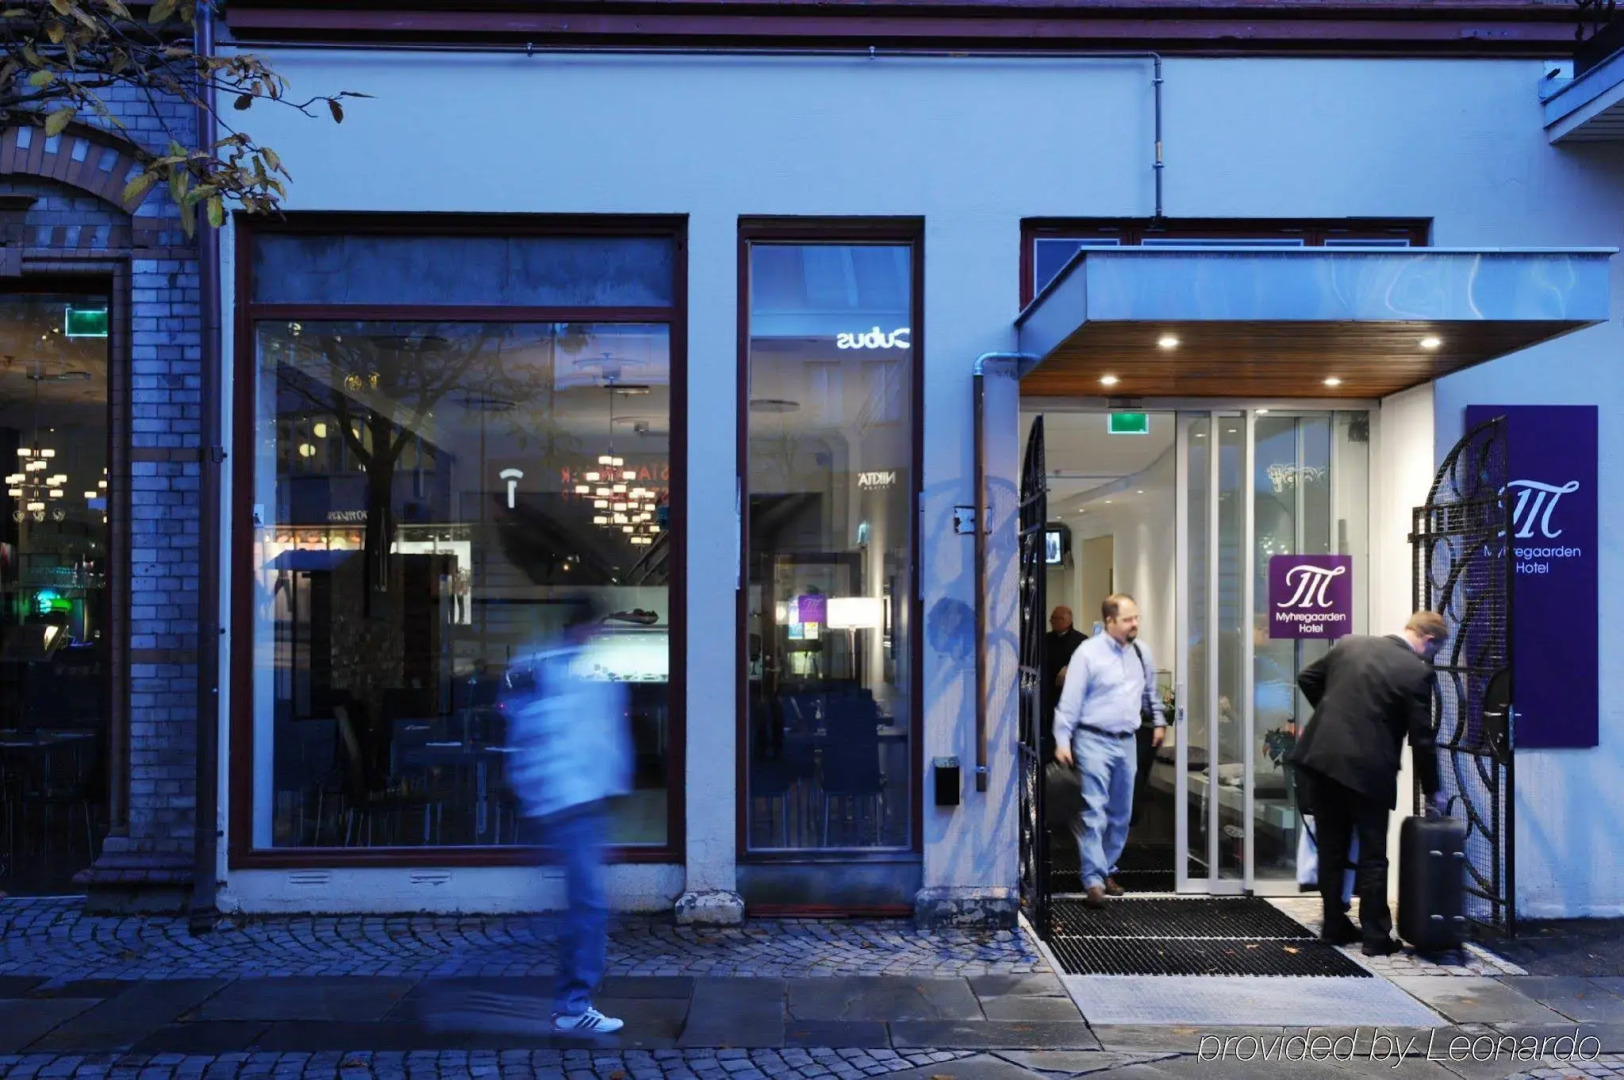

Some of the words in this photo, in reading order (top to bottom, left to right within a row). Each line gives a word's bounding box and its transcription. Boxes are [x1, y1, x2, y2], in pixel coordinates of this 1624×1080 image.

[1483, 545, 1582, 560] Myegaarden
[1516, 562, 1549, 573] Hotel
[1275, 612, 1346, 623] Myhregaarden
[1298, 624, 1324, 633] Hotel
